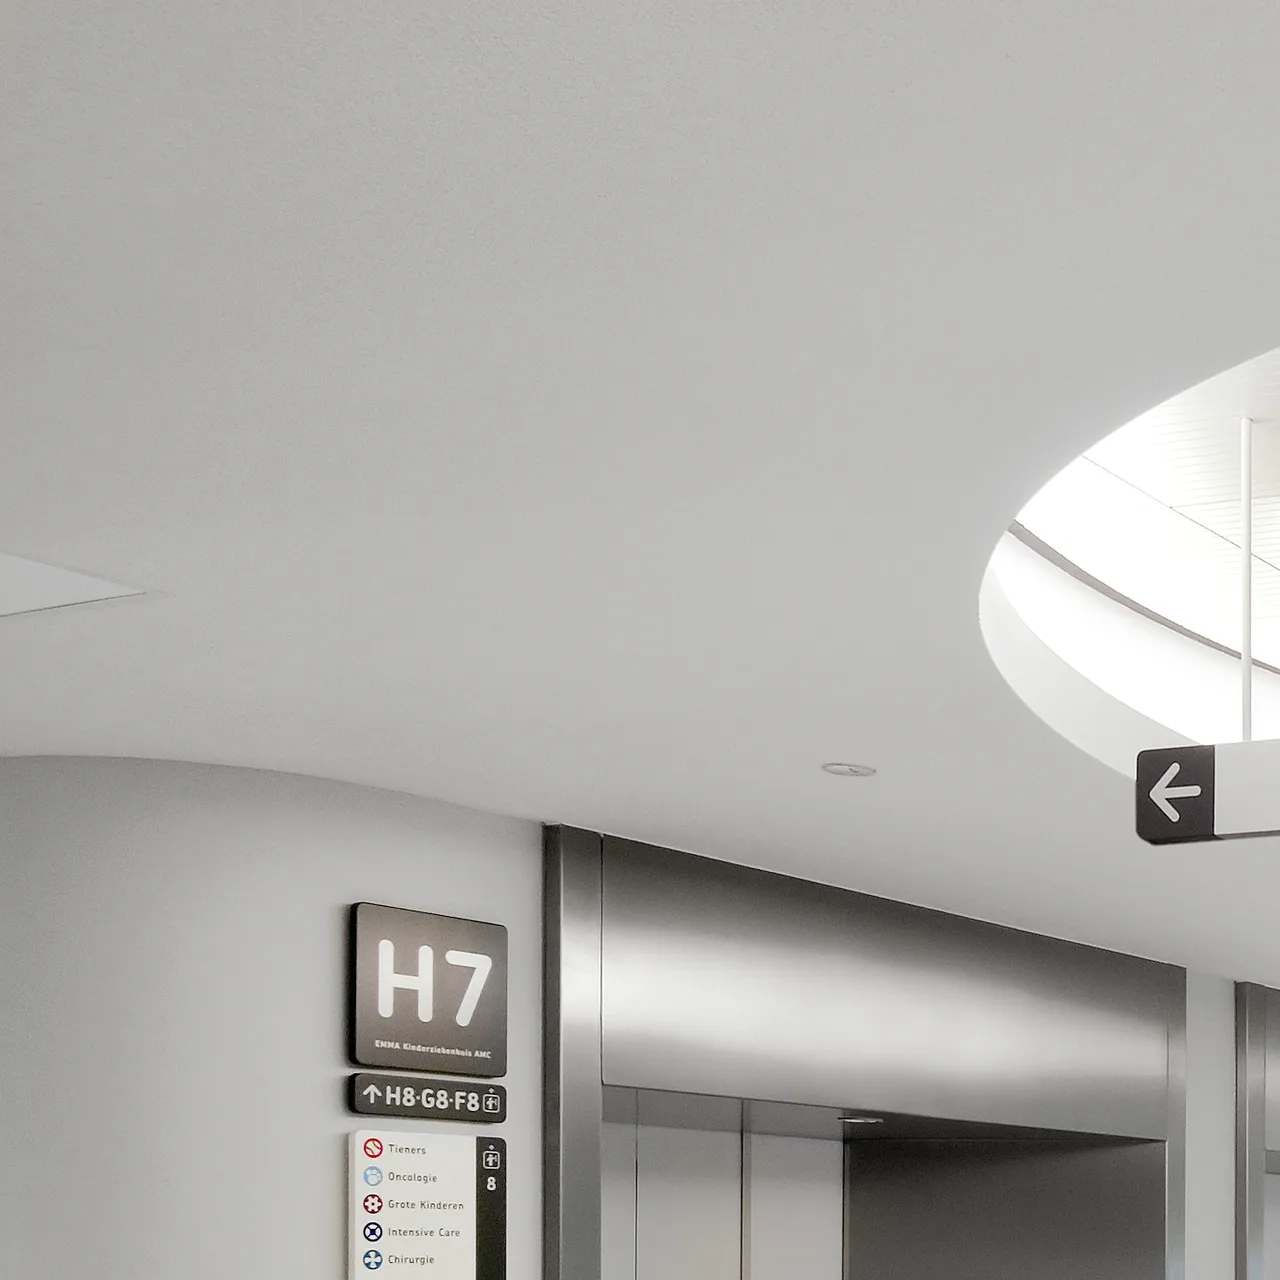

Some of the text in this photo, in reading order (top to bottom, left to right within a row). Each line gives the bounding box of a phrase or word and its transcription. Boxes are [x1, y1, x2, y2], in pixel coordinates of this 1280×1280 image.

[378, 938, 493, 1027] H7
[374, 1039, 400, 1050] EMMA
[474, 1049, 492, 1060] AMC
[388, 1143, 427, 1155] Tieners
[388, 1171, 438, 1183] Oncologie
[486, 1176, 496, 1191] 8
[388, 1200, 464, 1211] Grote Kinderen
[388, 1227, 461, 1237] Intensive Care
[388, 1255, 435, 1266] Chirurgie
